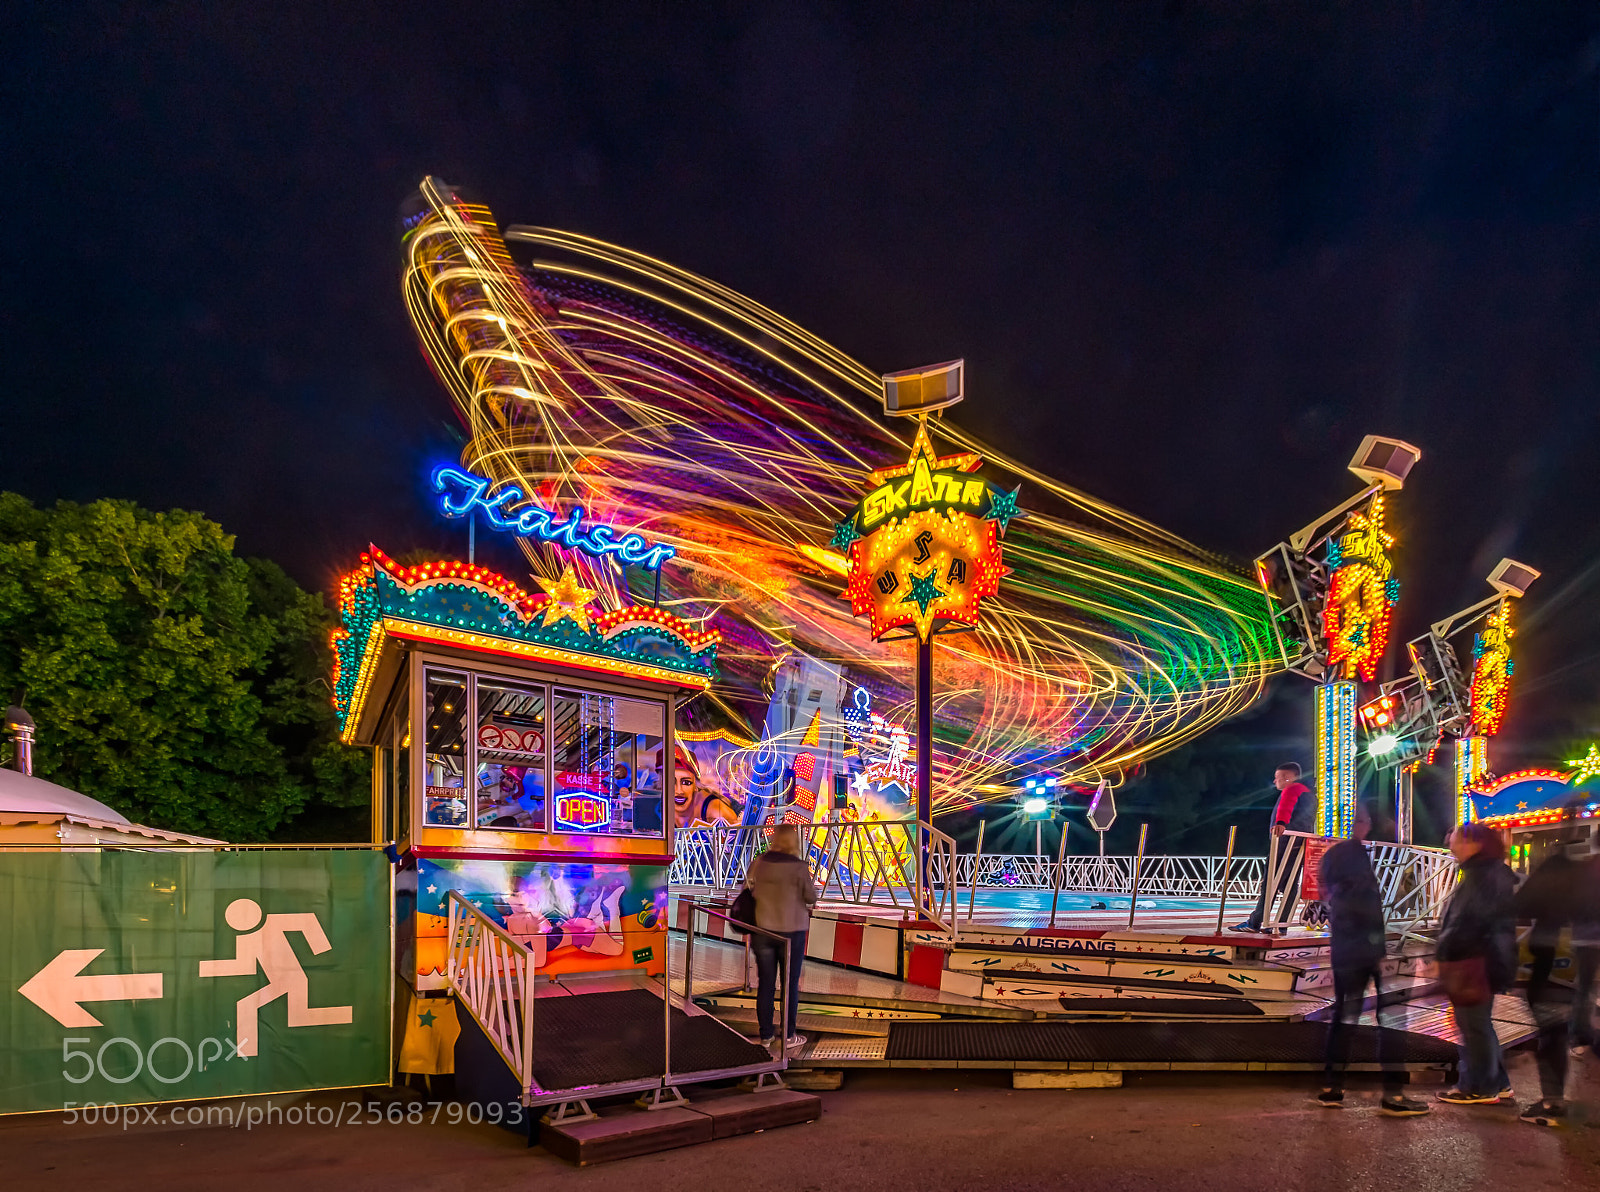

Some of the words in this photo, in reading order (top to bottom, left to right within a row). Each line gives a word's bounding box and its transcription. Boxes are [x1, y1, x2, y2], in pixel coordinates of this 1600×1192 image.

[863, 458, 984, 527] SKATER
[435, 466, 675, 570] Kaiser
[566, 774, 594, 786] KASSE
[558, 799, 606, 823] OPEN
[1012, 936, 1117, 952] AUSGANG
